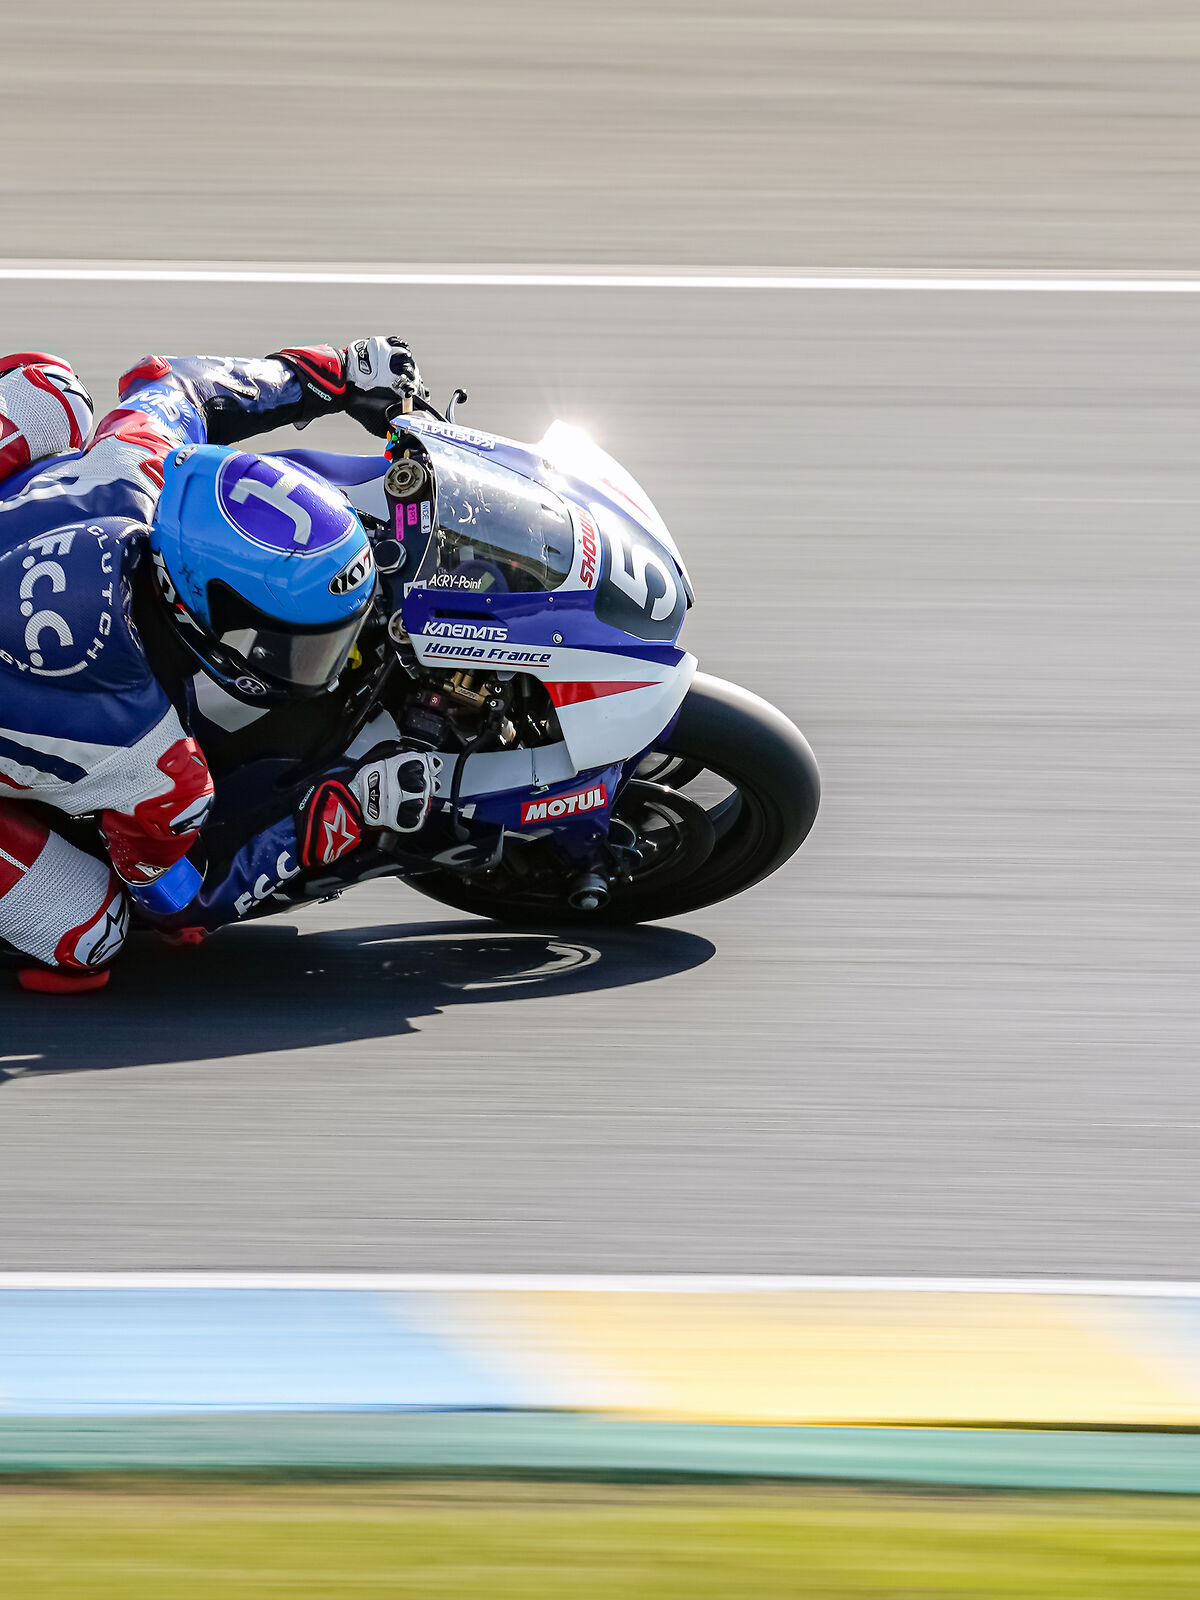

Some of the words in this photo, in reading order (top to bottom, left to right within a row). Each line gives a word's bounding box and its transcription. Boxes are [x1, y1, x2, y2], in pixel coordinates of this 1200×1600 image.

[330, 547, 372, 594] KYT
[598, 502, 676, 621] 5
[87, 525, 113, 661] CLUTCH
[428, 573, 482, 590] ACRY-Point
[422, 620, 508, 641] KANEMATS
[425, 642, 485, 660] Honda
[487, 646, 552, 663] France
[525, 788, 605, 822] MOTUL
